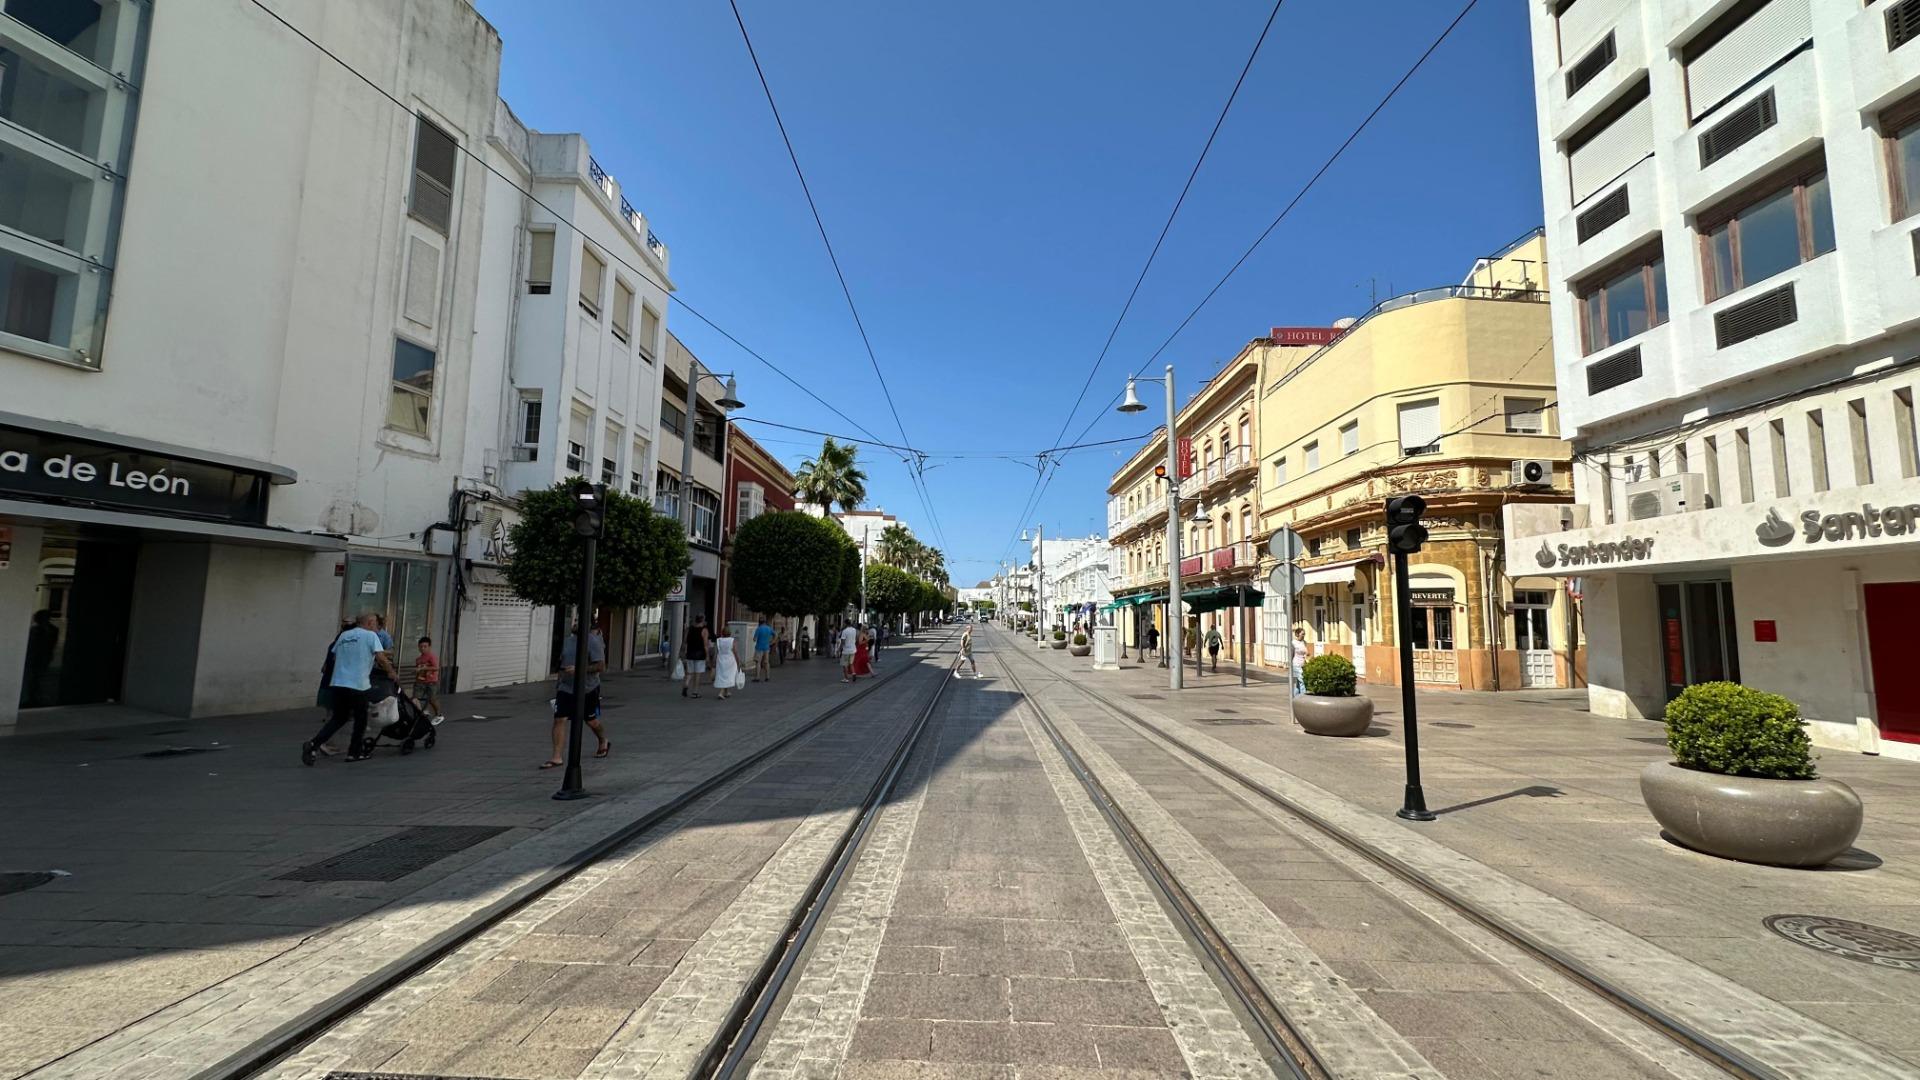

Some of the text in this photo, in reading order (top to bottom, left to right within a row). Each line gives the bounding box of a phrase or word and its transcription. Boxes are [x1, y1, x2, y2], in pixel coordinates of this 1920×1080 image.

[1287, 331, 1324, 340] HOTEL
[1180, 440, 1189, 475] HOTEL
[43, 454, 97, 482] de
[109, 462, 190, 496] León
[1558, 535, 1654, 567] Santander
